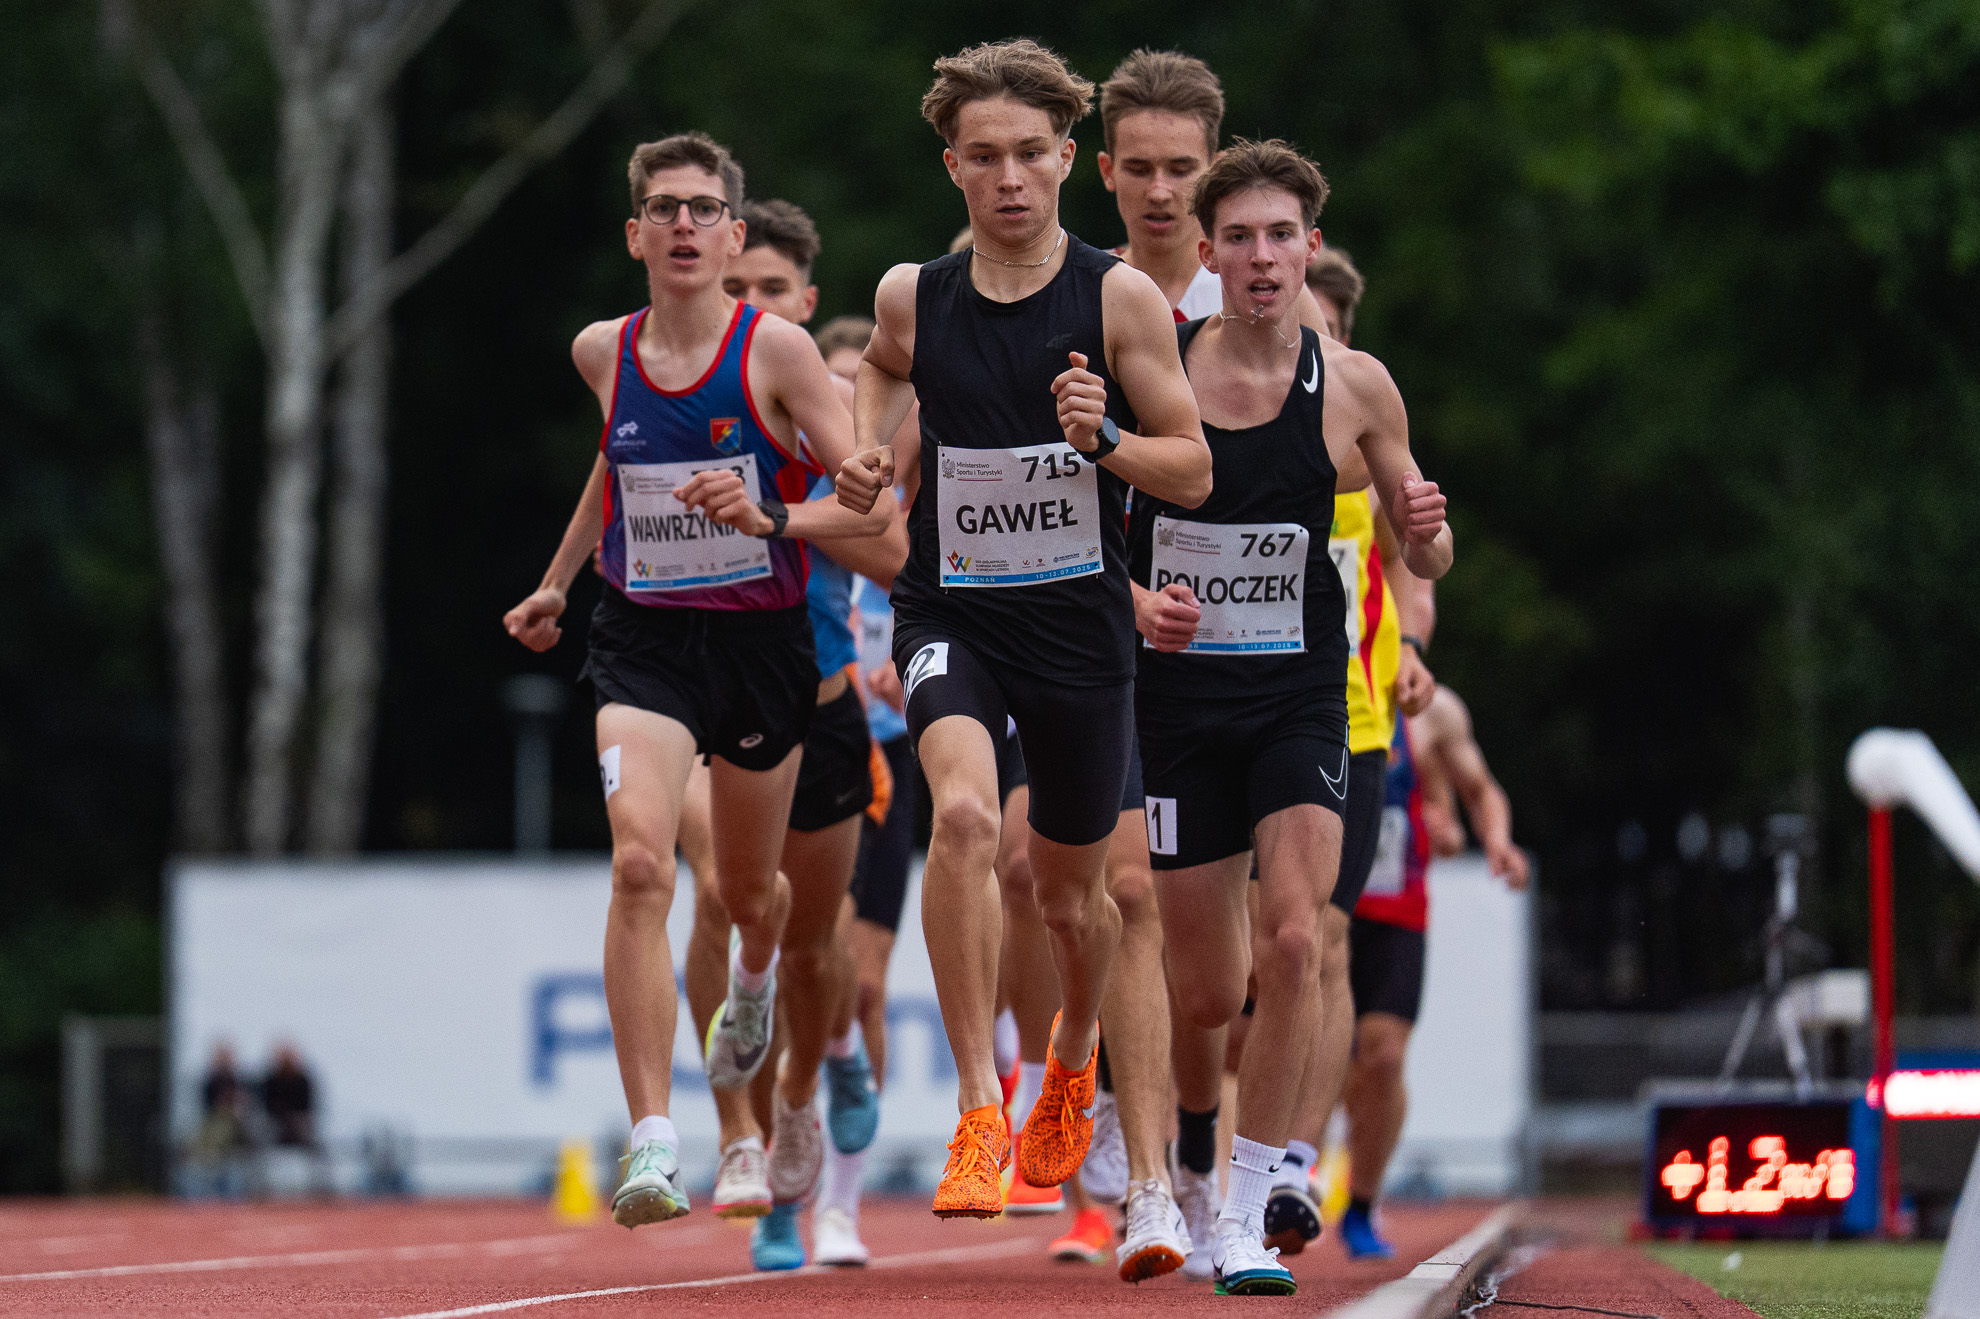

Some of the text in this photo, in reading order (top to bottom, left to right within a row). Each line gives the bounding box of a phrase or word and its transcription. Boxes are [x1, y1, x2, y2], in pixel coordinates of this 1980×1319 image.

[1021, 452, 1080, 482] 715
[629, 512, 736, 542] WAWRZYN
[956, 498, 1078, 534] GAWEŁ
[1240, 533, 1296, 557] 767
[1151, 802, 1162, 849] 1
